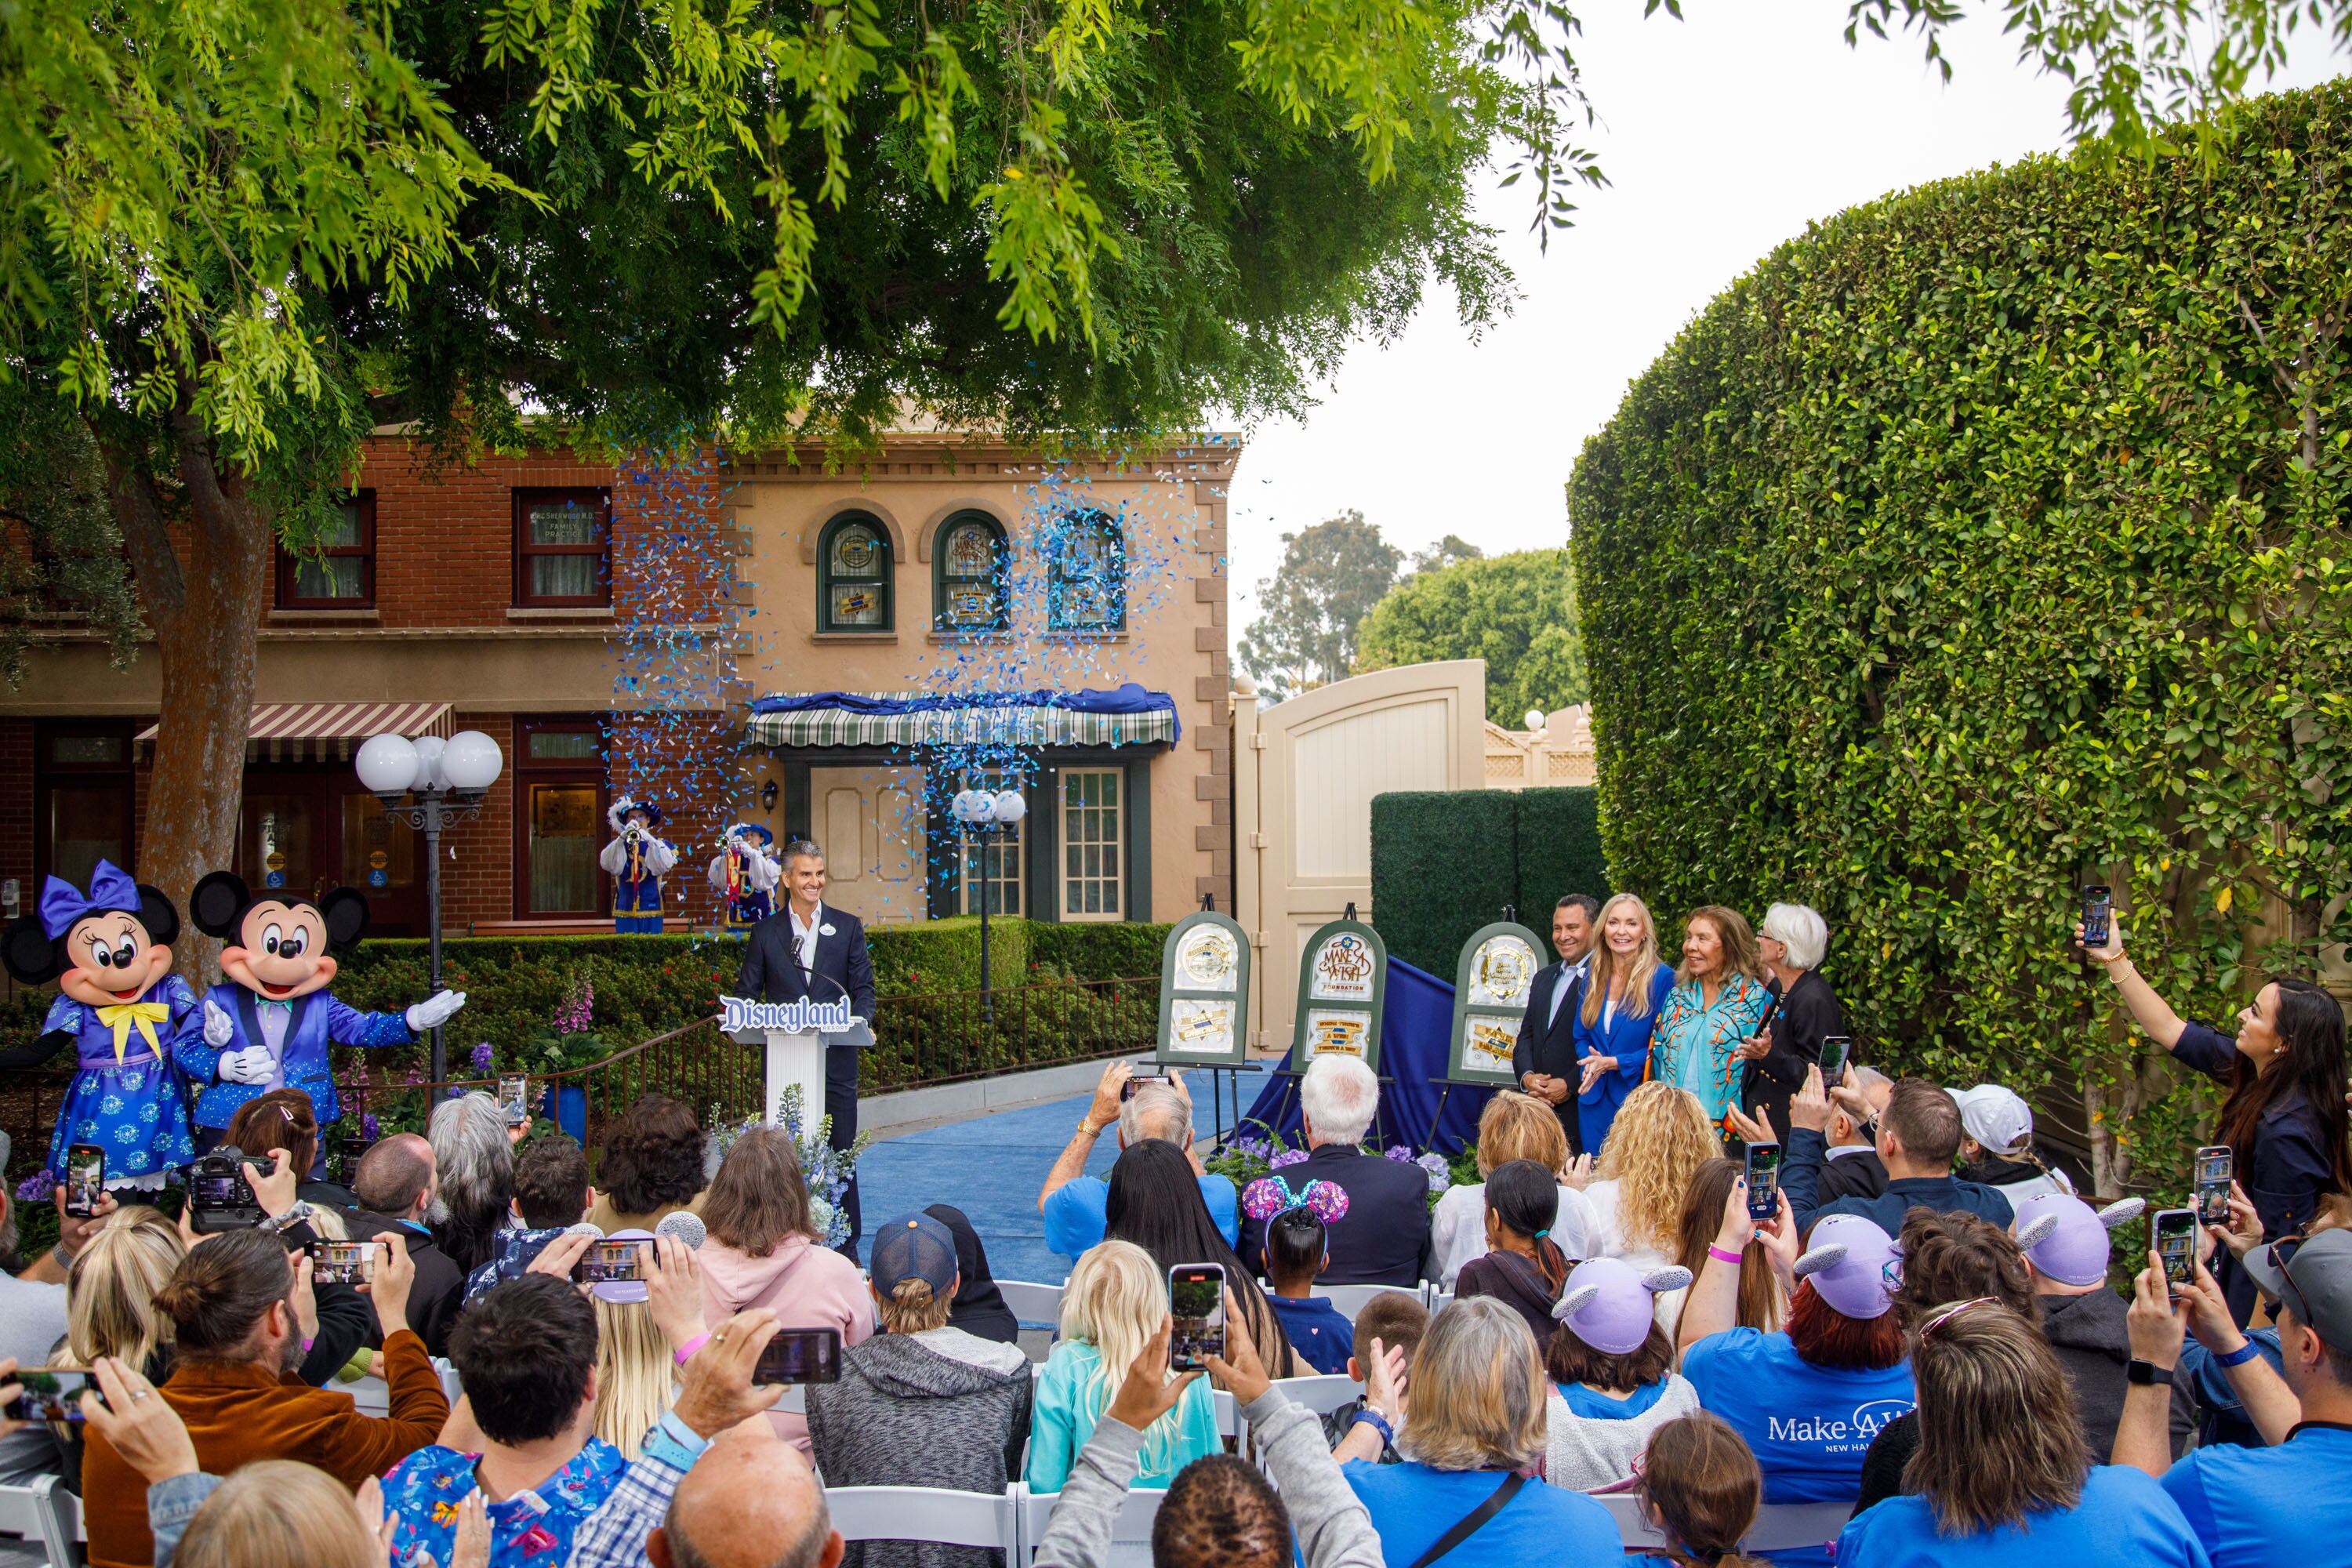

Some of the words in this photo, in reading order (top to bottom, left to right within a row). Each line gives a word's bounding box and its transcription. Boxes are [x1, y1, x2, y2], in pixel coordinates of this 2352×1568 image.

[1323, 949, 1353, 965] MAKE
[1327, 965, 1361, 982] WISH
[720, 996, 849, 1032] Disneyland
[1826, 1443, 1849, 1453] NEW
